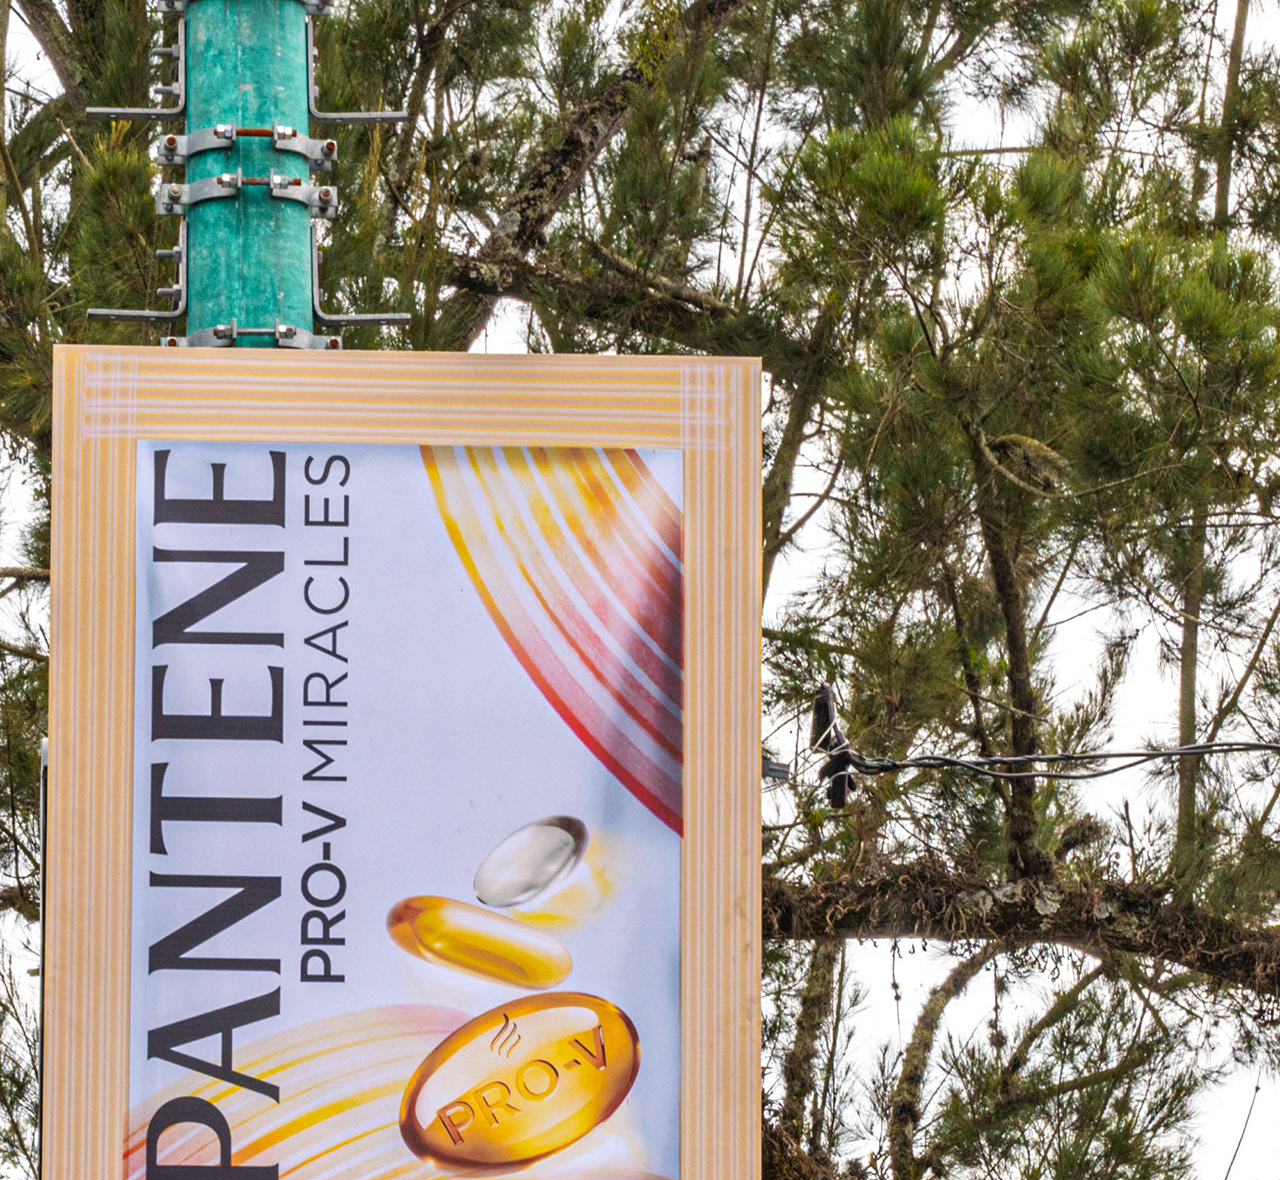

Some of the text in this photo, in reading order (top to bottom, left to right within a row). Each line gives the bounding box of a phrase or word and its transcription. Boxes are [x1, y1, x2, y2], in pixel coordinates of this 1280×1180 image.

[300, 453, 351, 984] PRO-V MIRACLES
[436, 1024, 606, 1146] PRO-V
